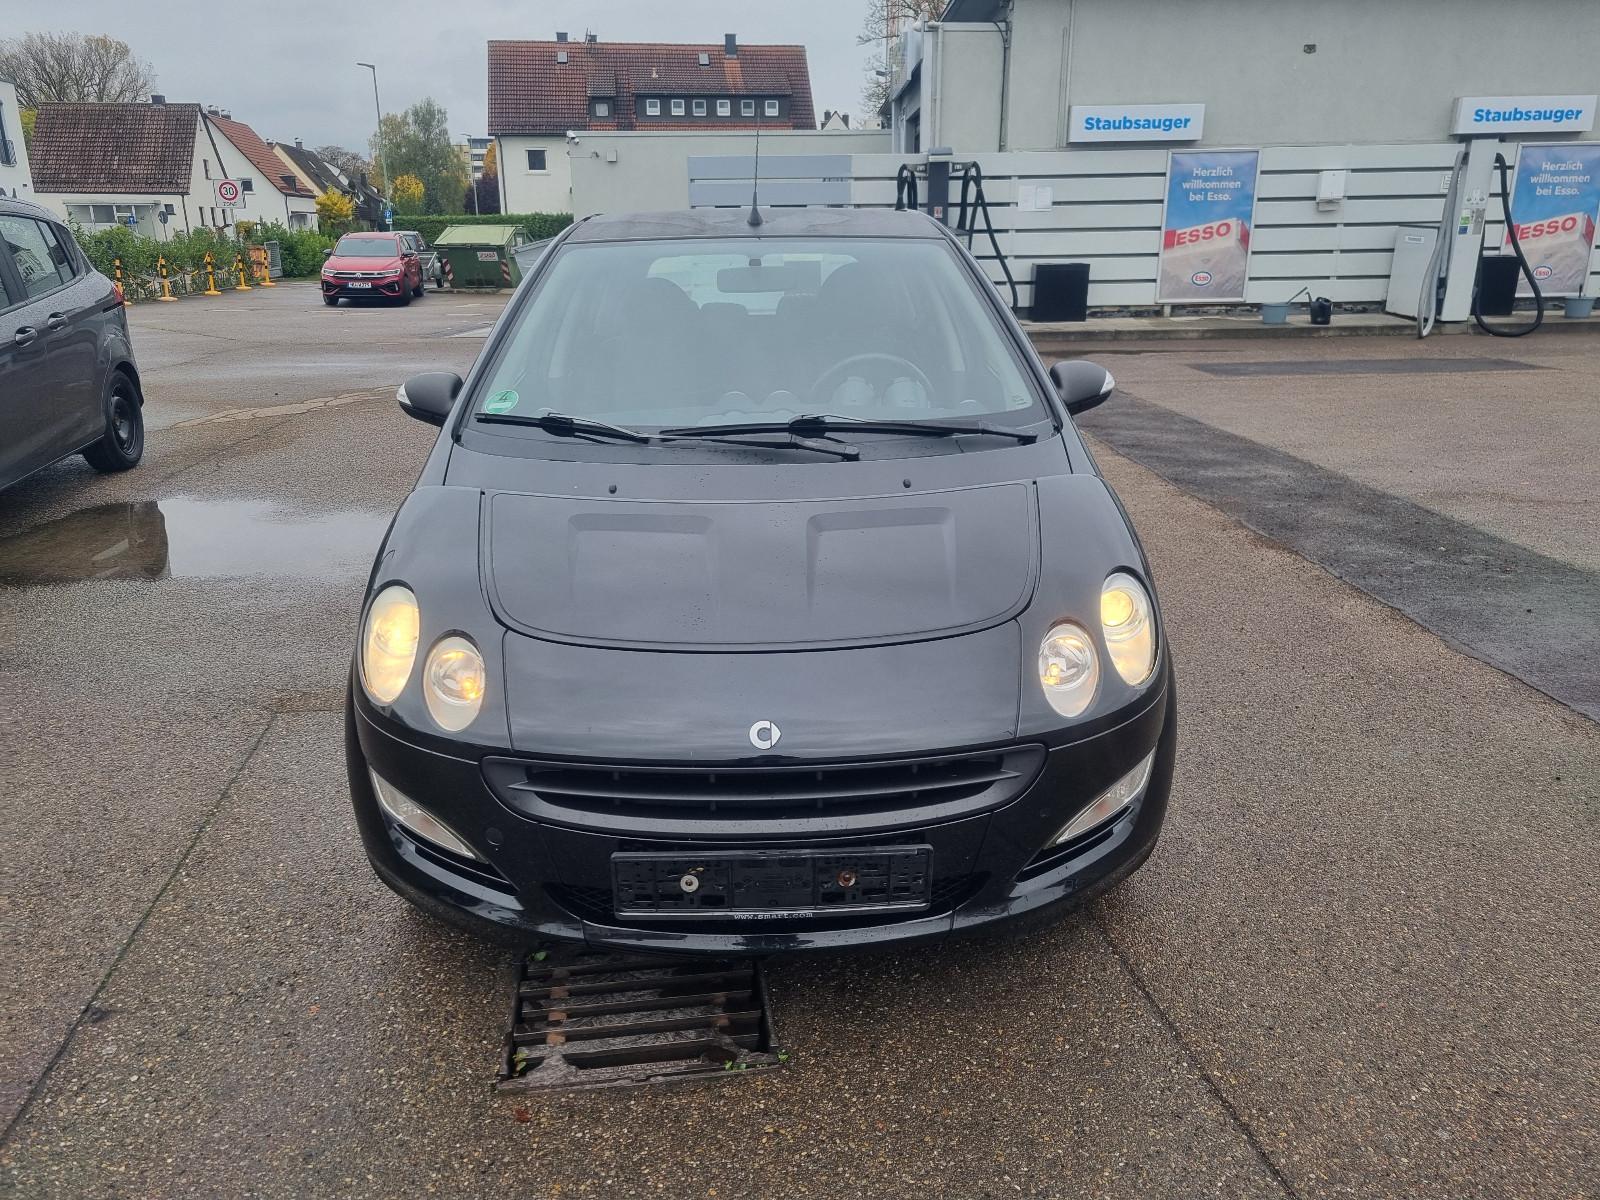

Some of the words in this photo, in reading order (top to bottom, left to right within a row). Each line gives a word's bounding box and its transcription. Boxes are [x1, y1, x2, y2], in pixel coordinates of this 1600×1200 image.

[1473, 107, 1583, 123] Staubsauger
[1084, 116, 1191, 132] Staubsauger
[1541, 161, 1583, 171] Herzlich
[1192, 166, 1233, 177] Herzlich
[1530, 173, 1590, 183] willkommen
[1182, 179, 1241, 189] willkommen
[222, 186, 235, 196] 30
[1188, 191, 1205, 201] bei
[1207, 191, 1232, 201] Esso.
[1535, 186, 1552, 196] bei
[1554, 186, 1580, 195] Esso.
[1519, 216, 1577, 241] ESSO
[1175, 222, 1232, 246] ESSO
[1194, 274, 1209, 282] Esso
[734, 911, 813, 920] www.smart.com
